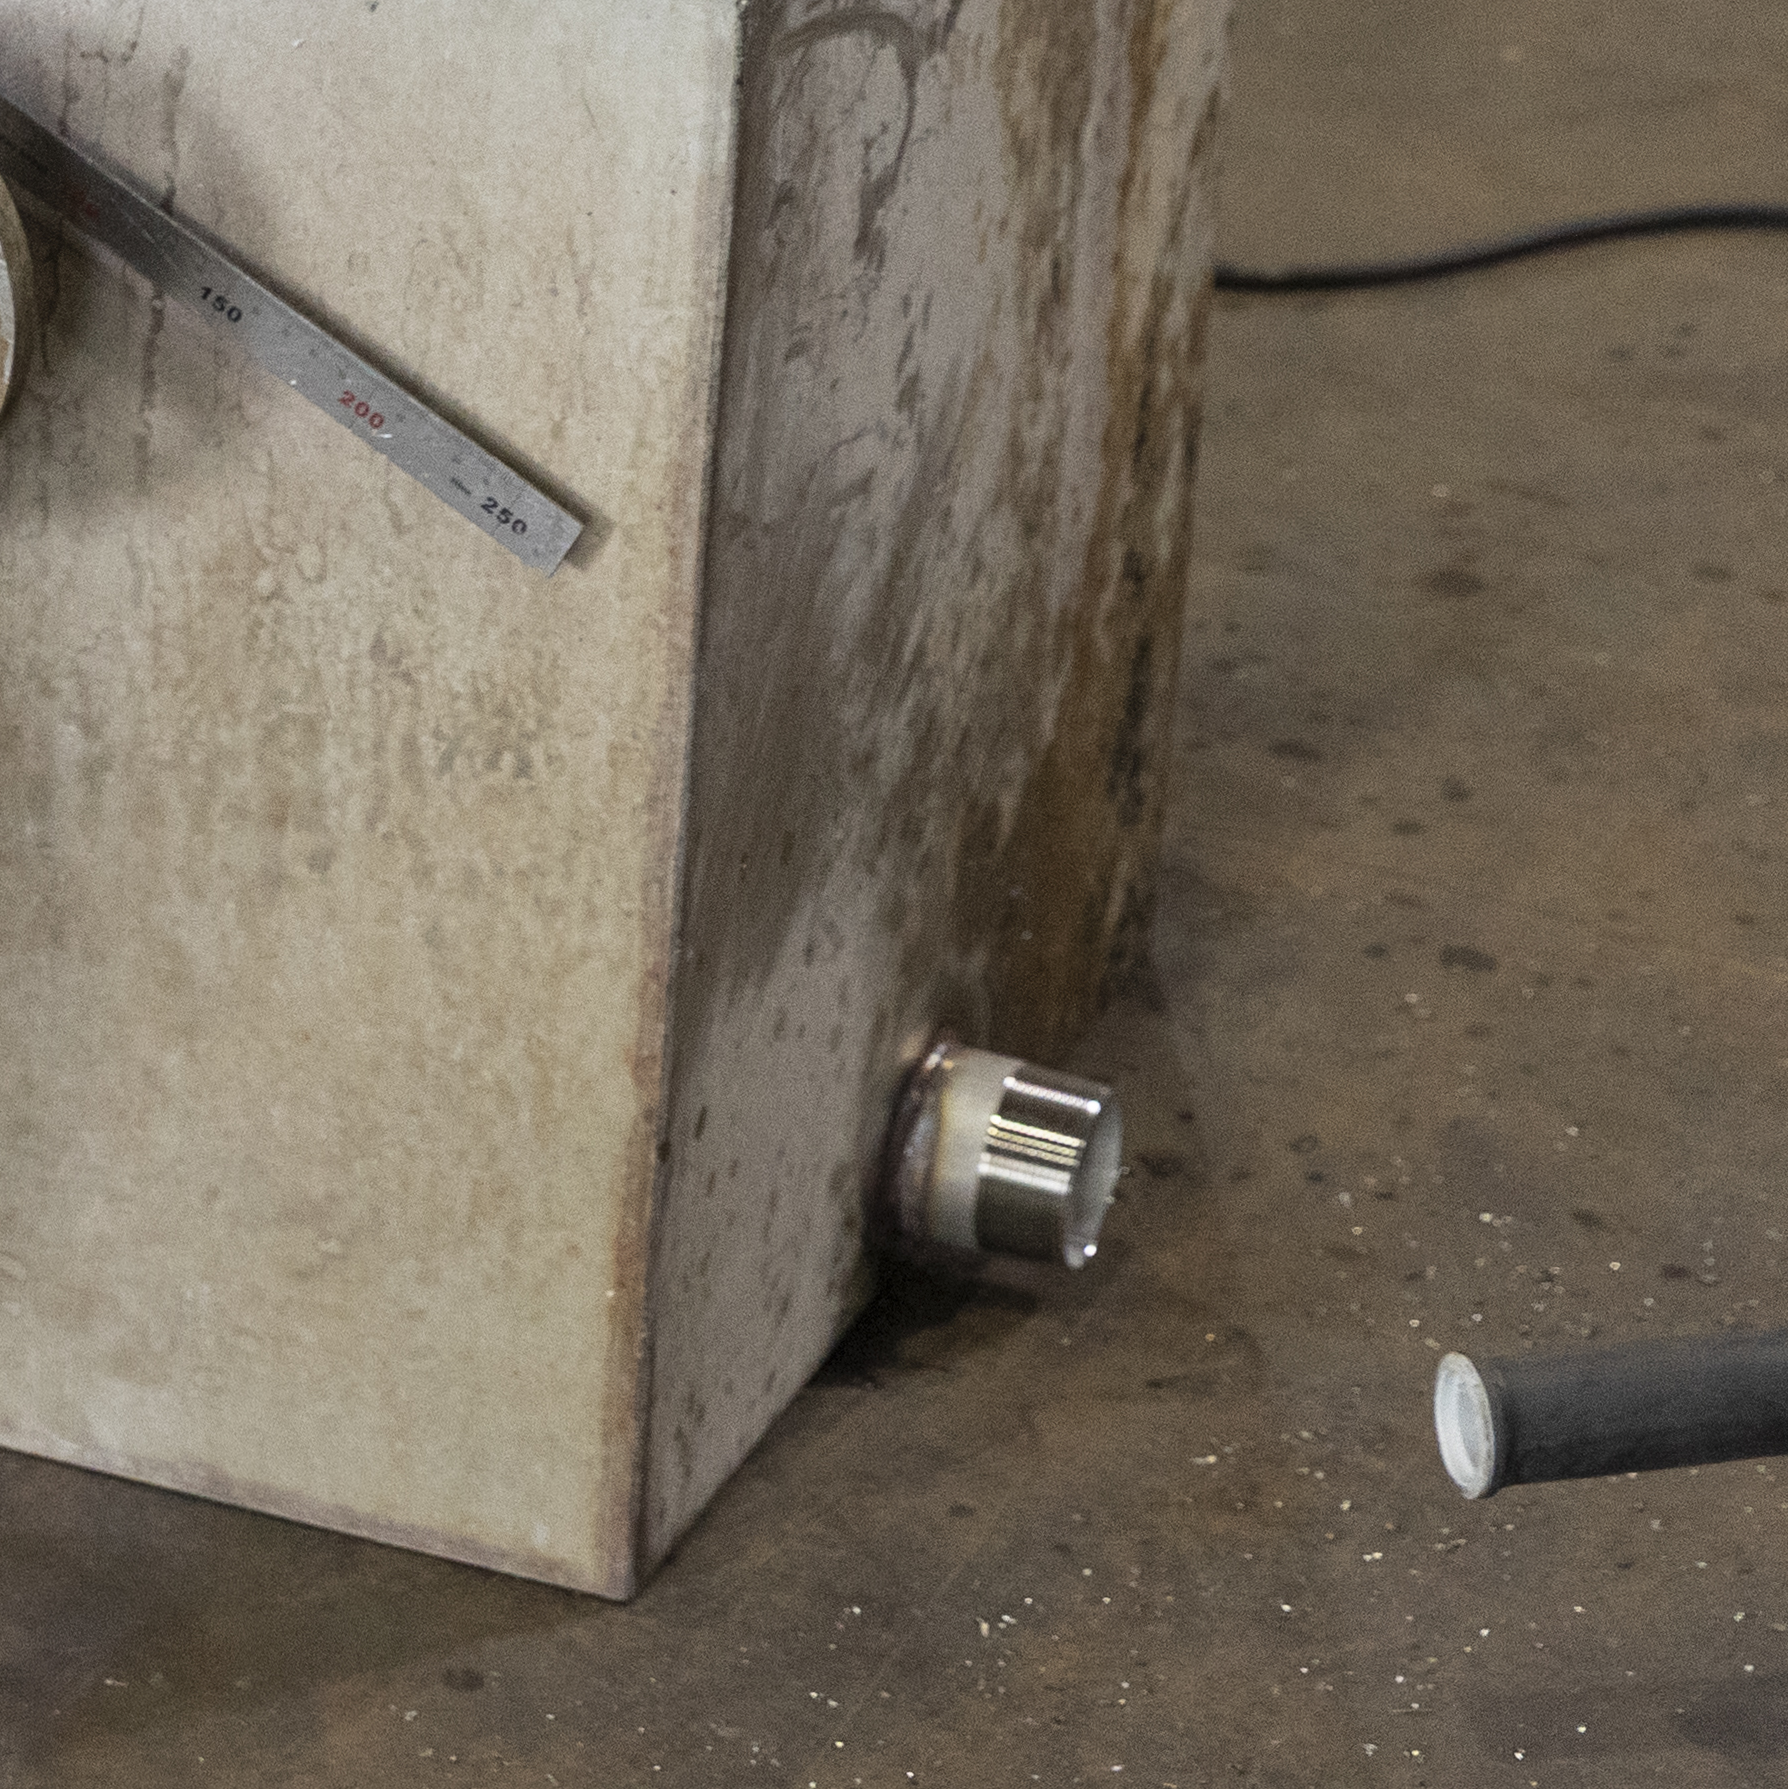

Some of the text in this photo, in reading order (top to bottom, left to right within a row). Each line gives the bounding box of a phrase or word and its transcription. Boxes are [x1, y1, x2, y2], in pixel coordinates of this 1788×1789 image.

[199, 286, 243, 323] 150
[338, 389, 385, 429] 200
[480, 496, 528, 535] 250
